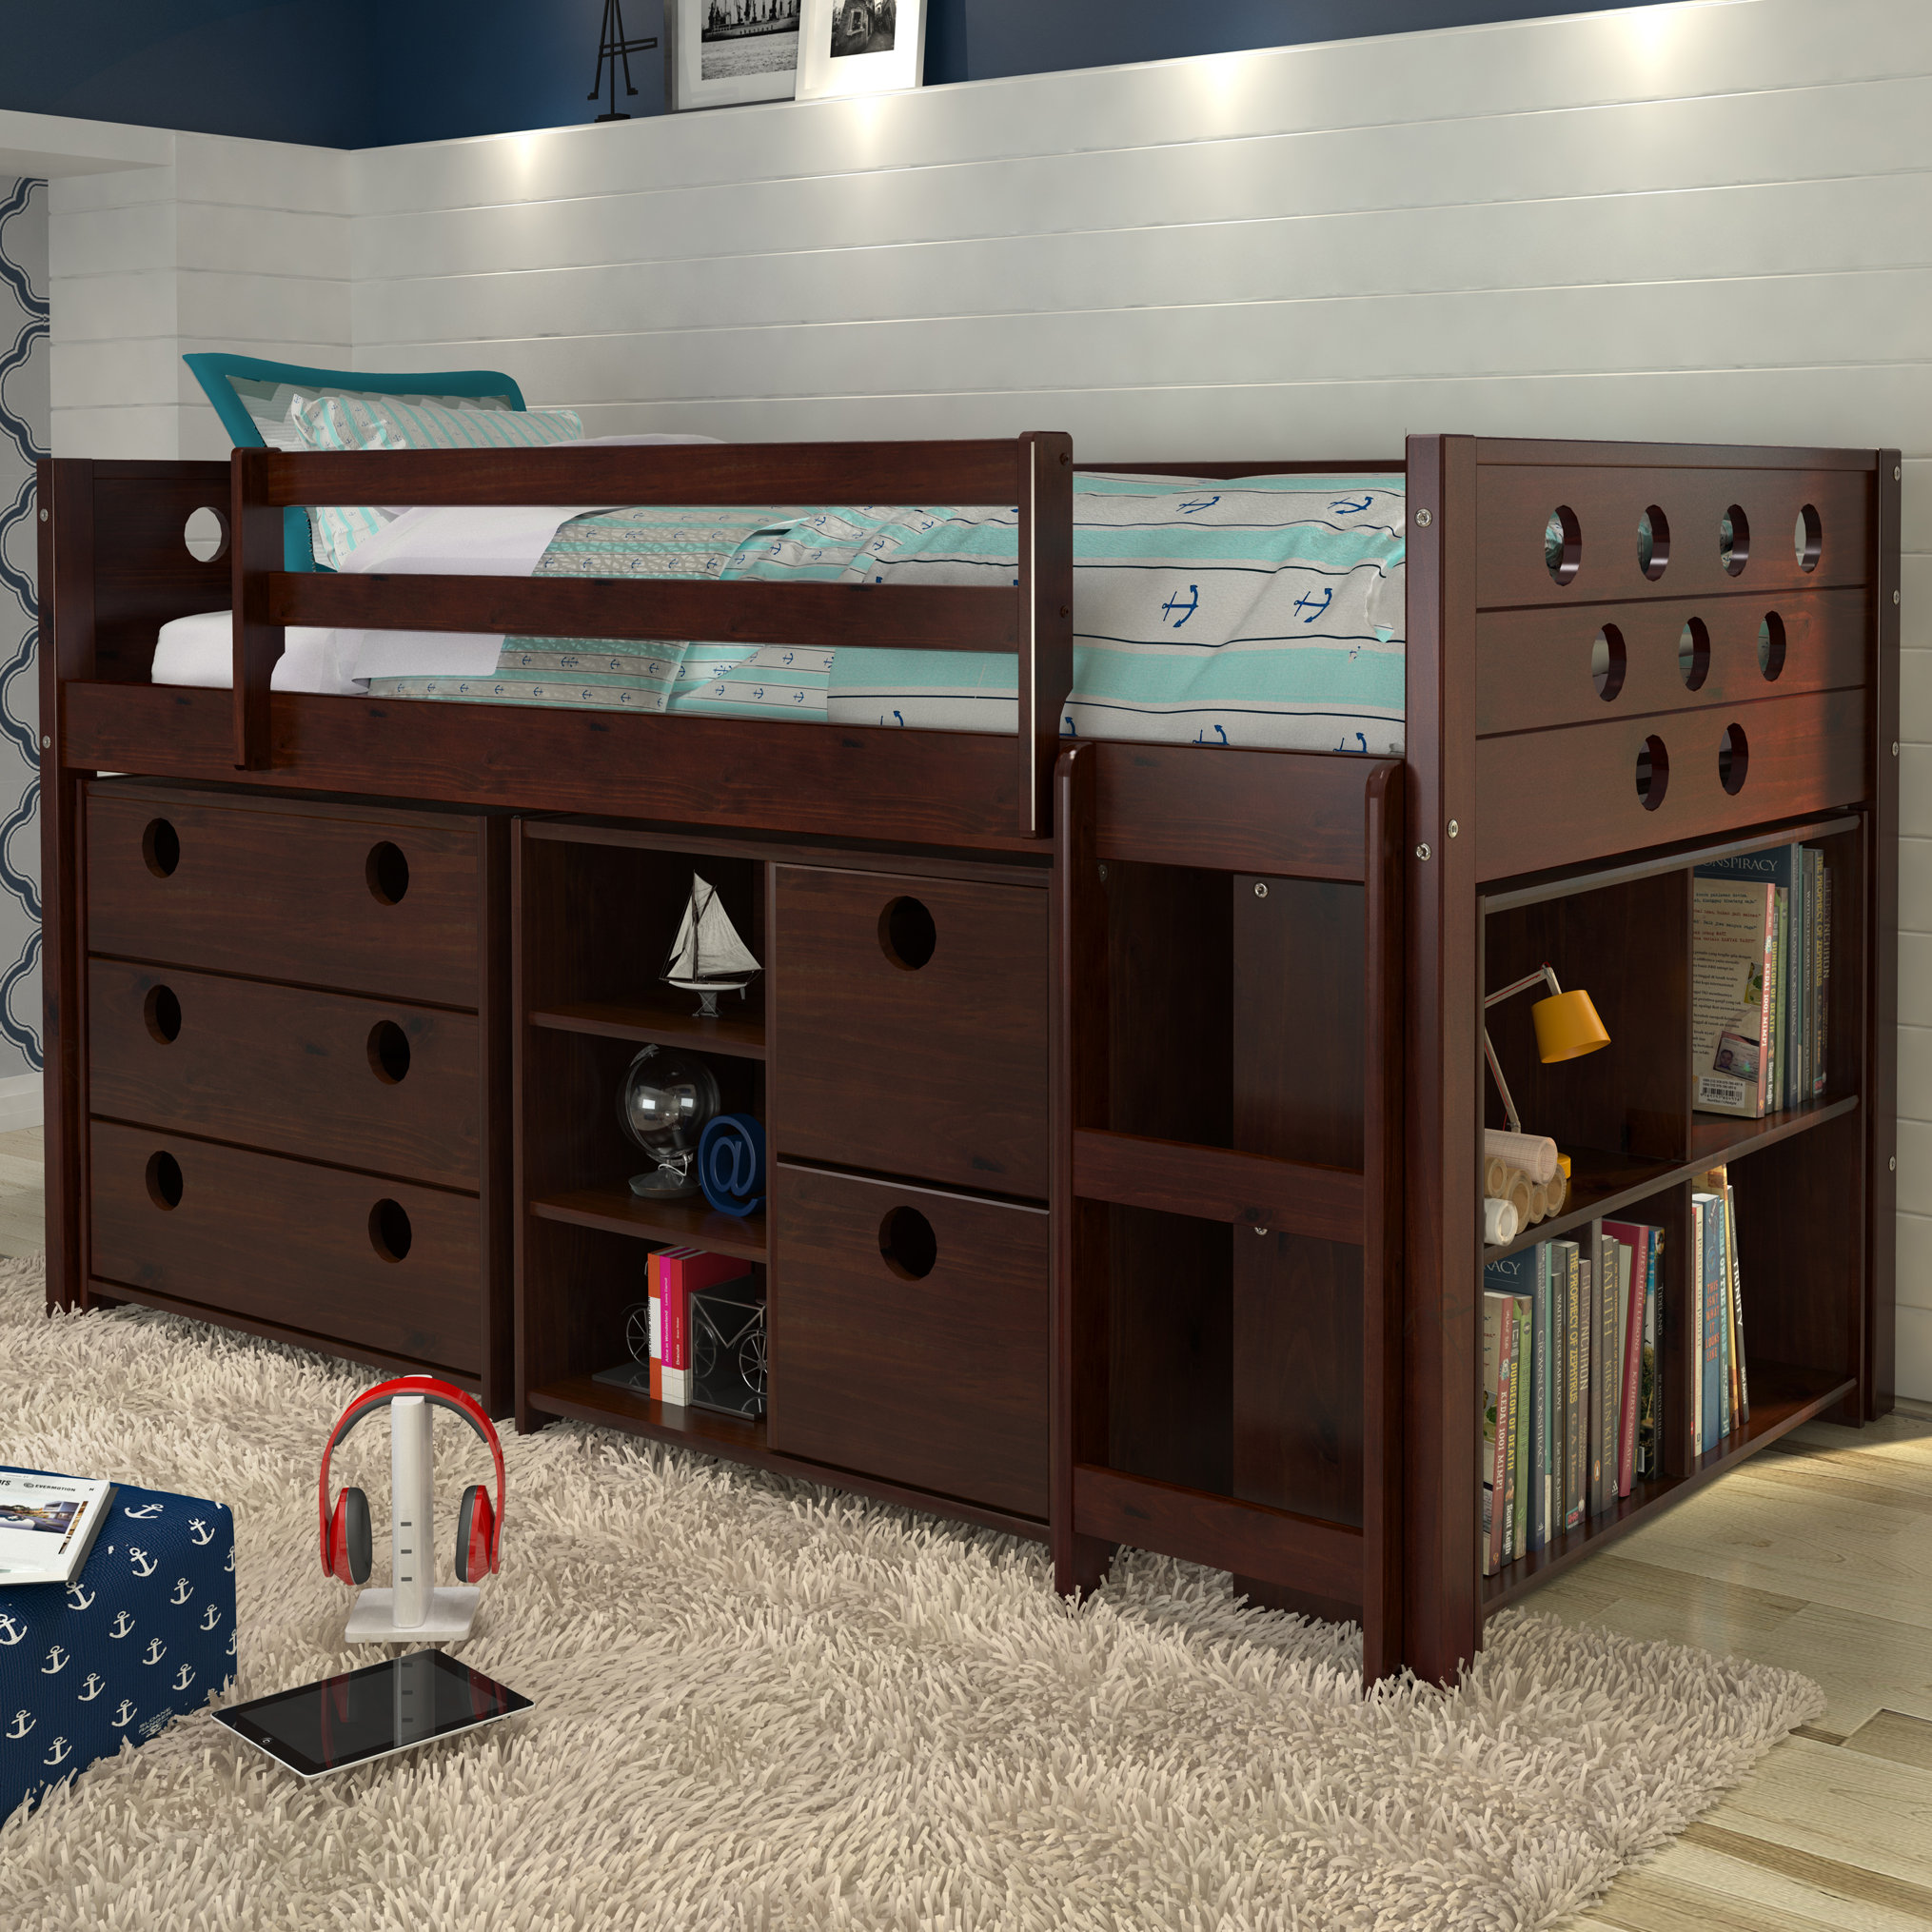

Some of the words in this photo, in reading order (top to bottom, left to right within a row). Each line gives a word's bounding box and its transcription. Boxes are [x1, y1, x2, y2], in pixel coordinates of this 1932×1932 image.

[1704, 857, 1778, 872] NSPIRACY
[1816, 924, 1824, 937] OF
[1770, 992, 1776, 1001] OF
[1569, 1251, 1578, 1271] THE
[1720, 1257, 1725, 1275] ON
[1706, 1279, 1719, 1295] THIS
[1733, 1258, 1743, 1327] TRINITY
[1569, 1272, 1578, 1329] PROPHECY
[1705, 1305, 1720, 1323] WHAT
[1569, 1331, 1578, 1347] OF
[1634, 1311, 1643, 1350] LESSONS
[1709, 1321, 1715, 1334] IT
[1705, 1332, 1720, 1350] LOOKS
[1508, 1362, 1518, 1415] DUNGEON
[1569, 1350, 1579, 1404] ZEPHYRUS
[1604, 1360, 1612, 1422] KIRSTEN
[1628, 1370, 1639, 1421] KATHRYN
[1499, 1391, 1508, 1425] KEDAI
[1508, 1417, 1516, 1431] OF
[1536, 1386, 1545, 1469] CONSPIRACY
[1497, 1428, 1506, 1451] 1001
[1604, 1426, 1612, 1469] KELLY
[1507, 1435, 1515, 1470] DEATH
[1495, 1453, 1505, 1491] MIMPI
[34, 1484, 76, 1492] EVERMOTION
